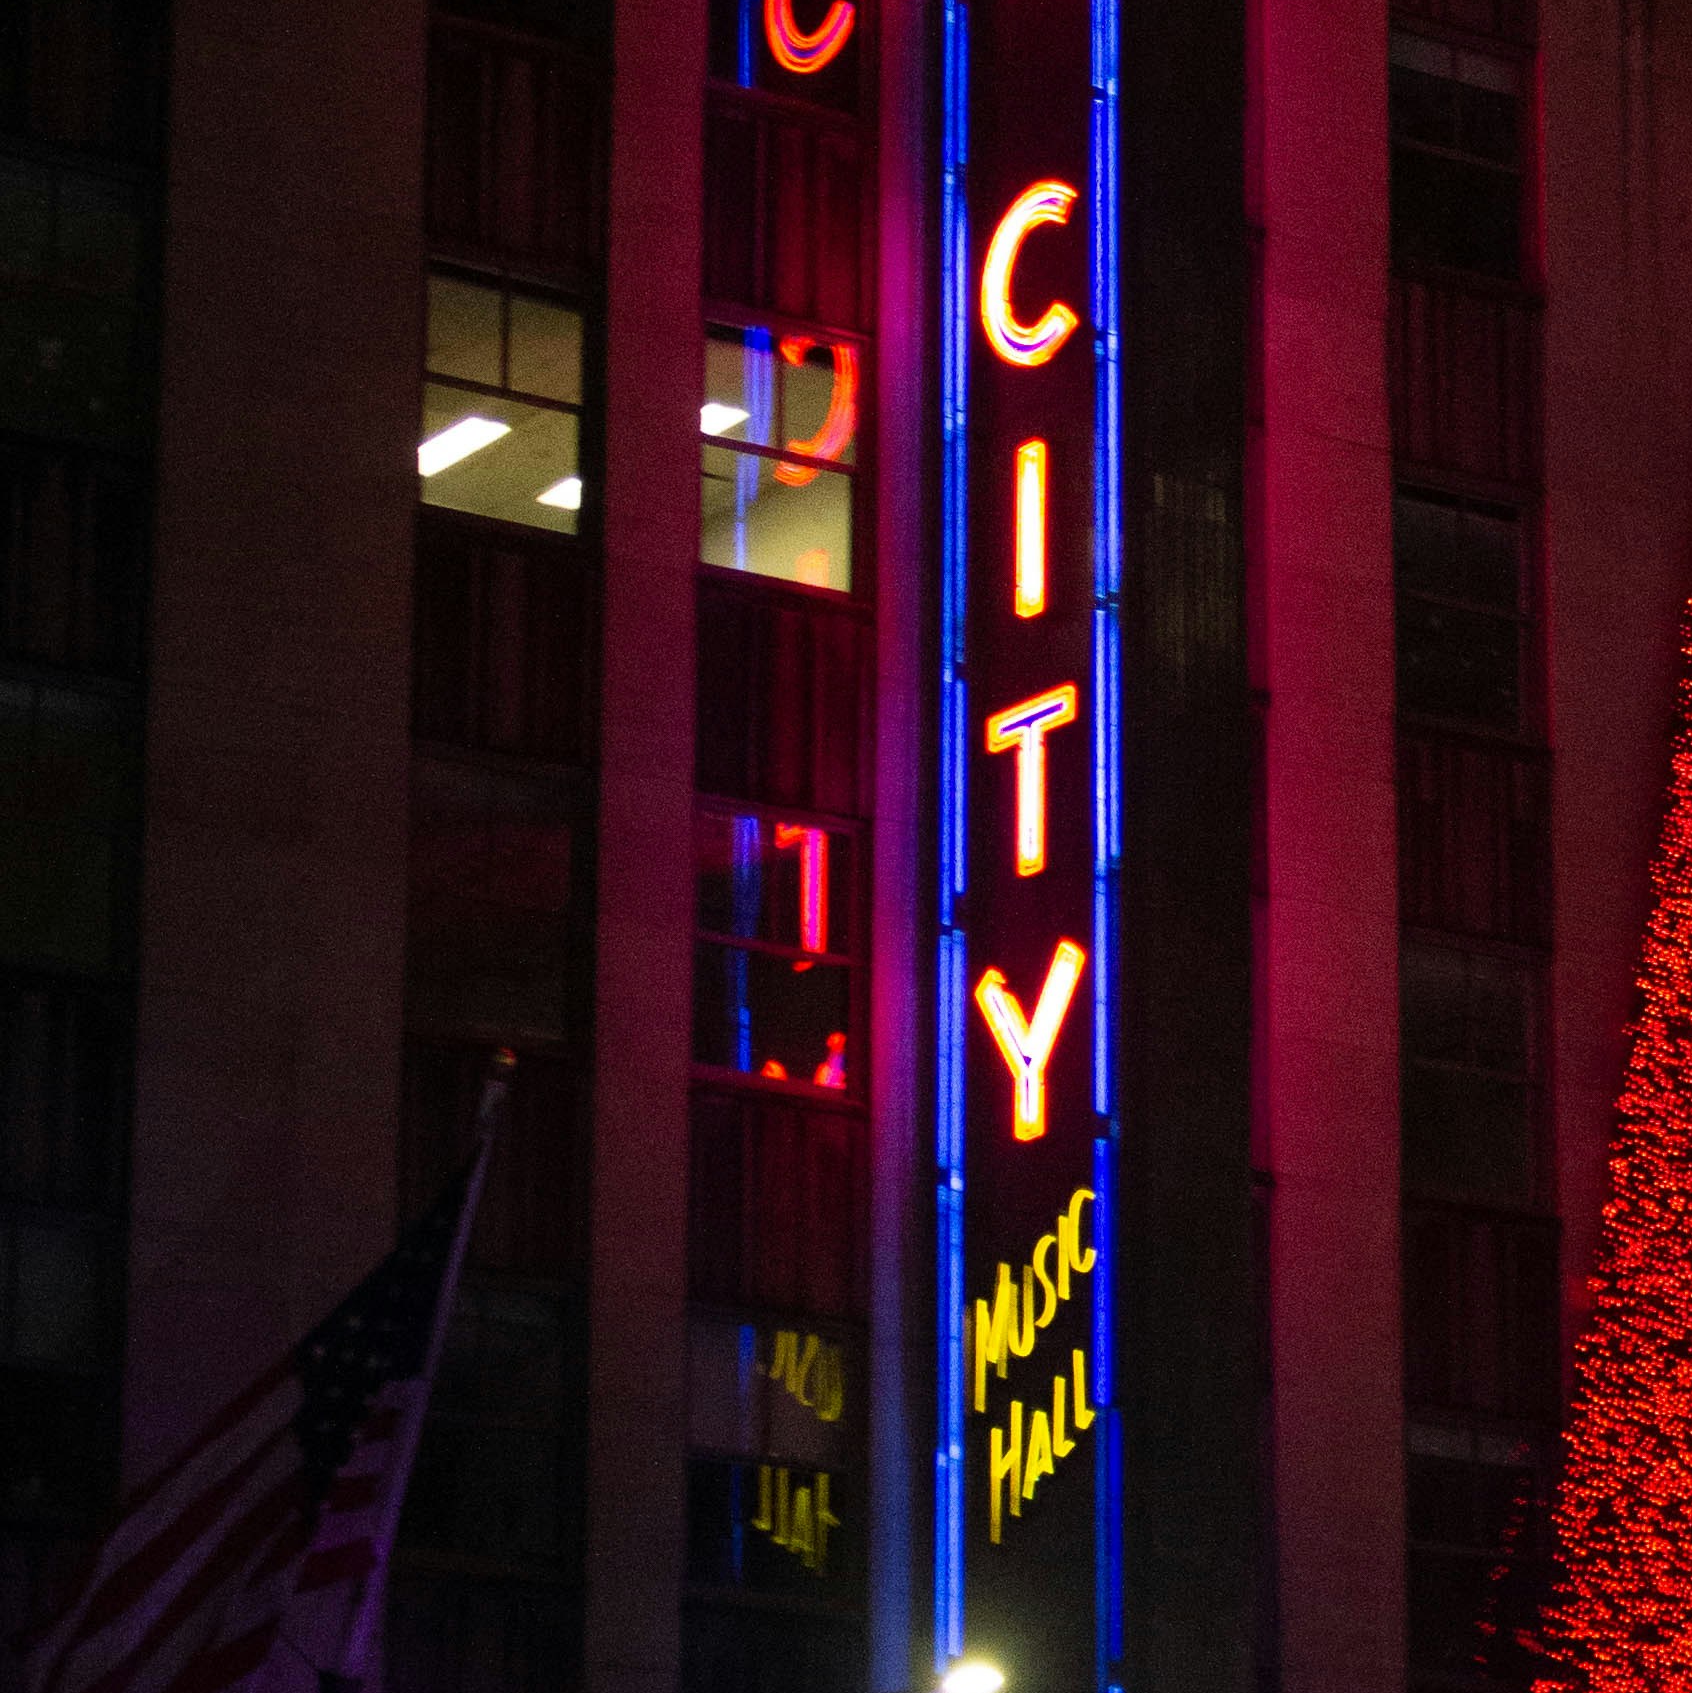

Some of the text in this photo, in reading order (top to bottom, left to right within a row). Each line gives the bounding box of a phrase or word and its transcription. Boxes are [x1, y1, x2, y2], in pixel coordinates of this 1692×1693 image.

[974, 178, 1086, 1144] CITY
[973, 1188, 1097, 1413] MUSIC
[989, 1348, 1096, 1545] HALL
